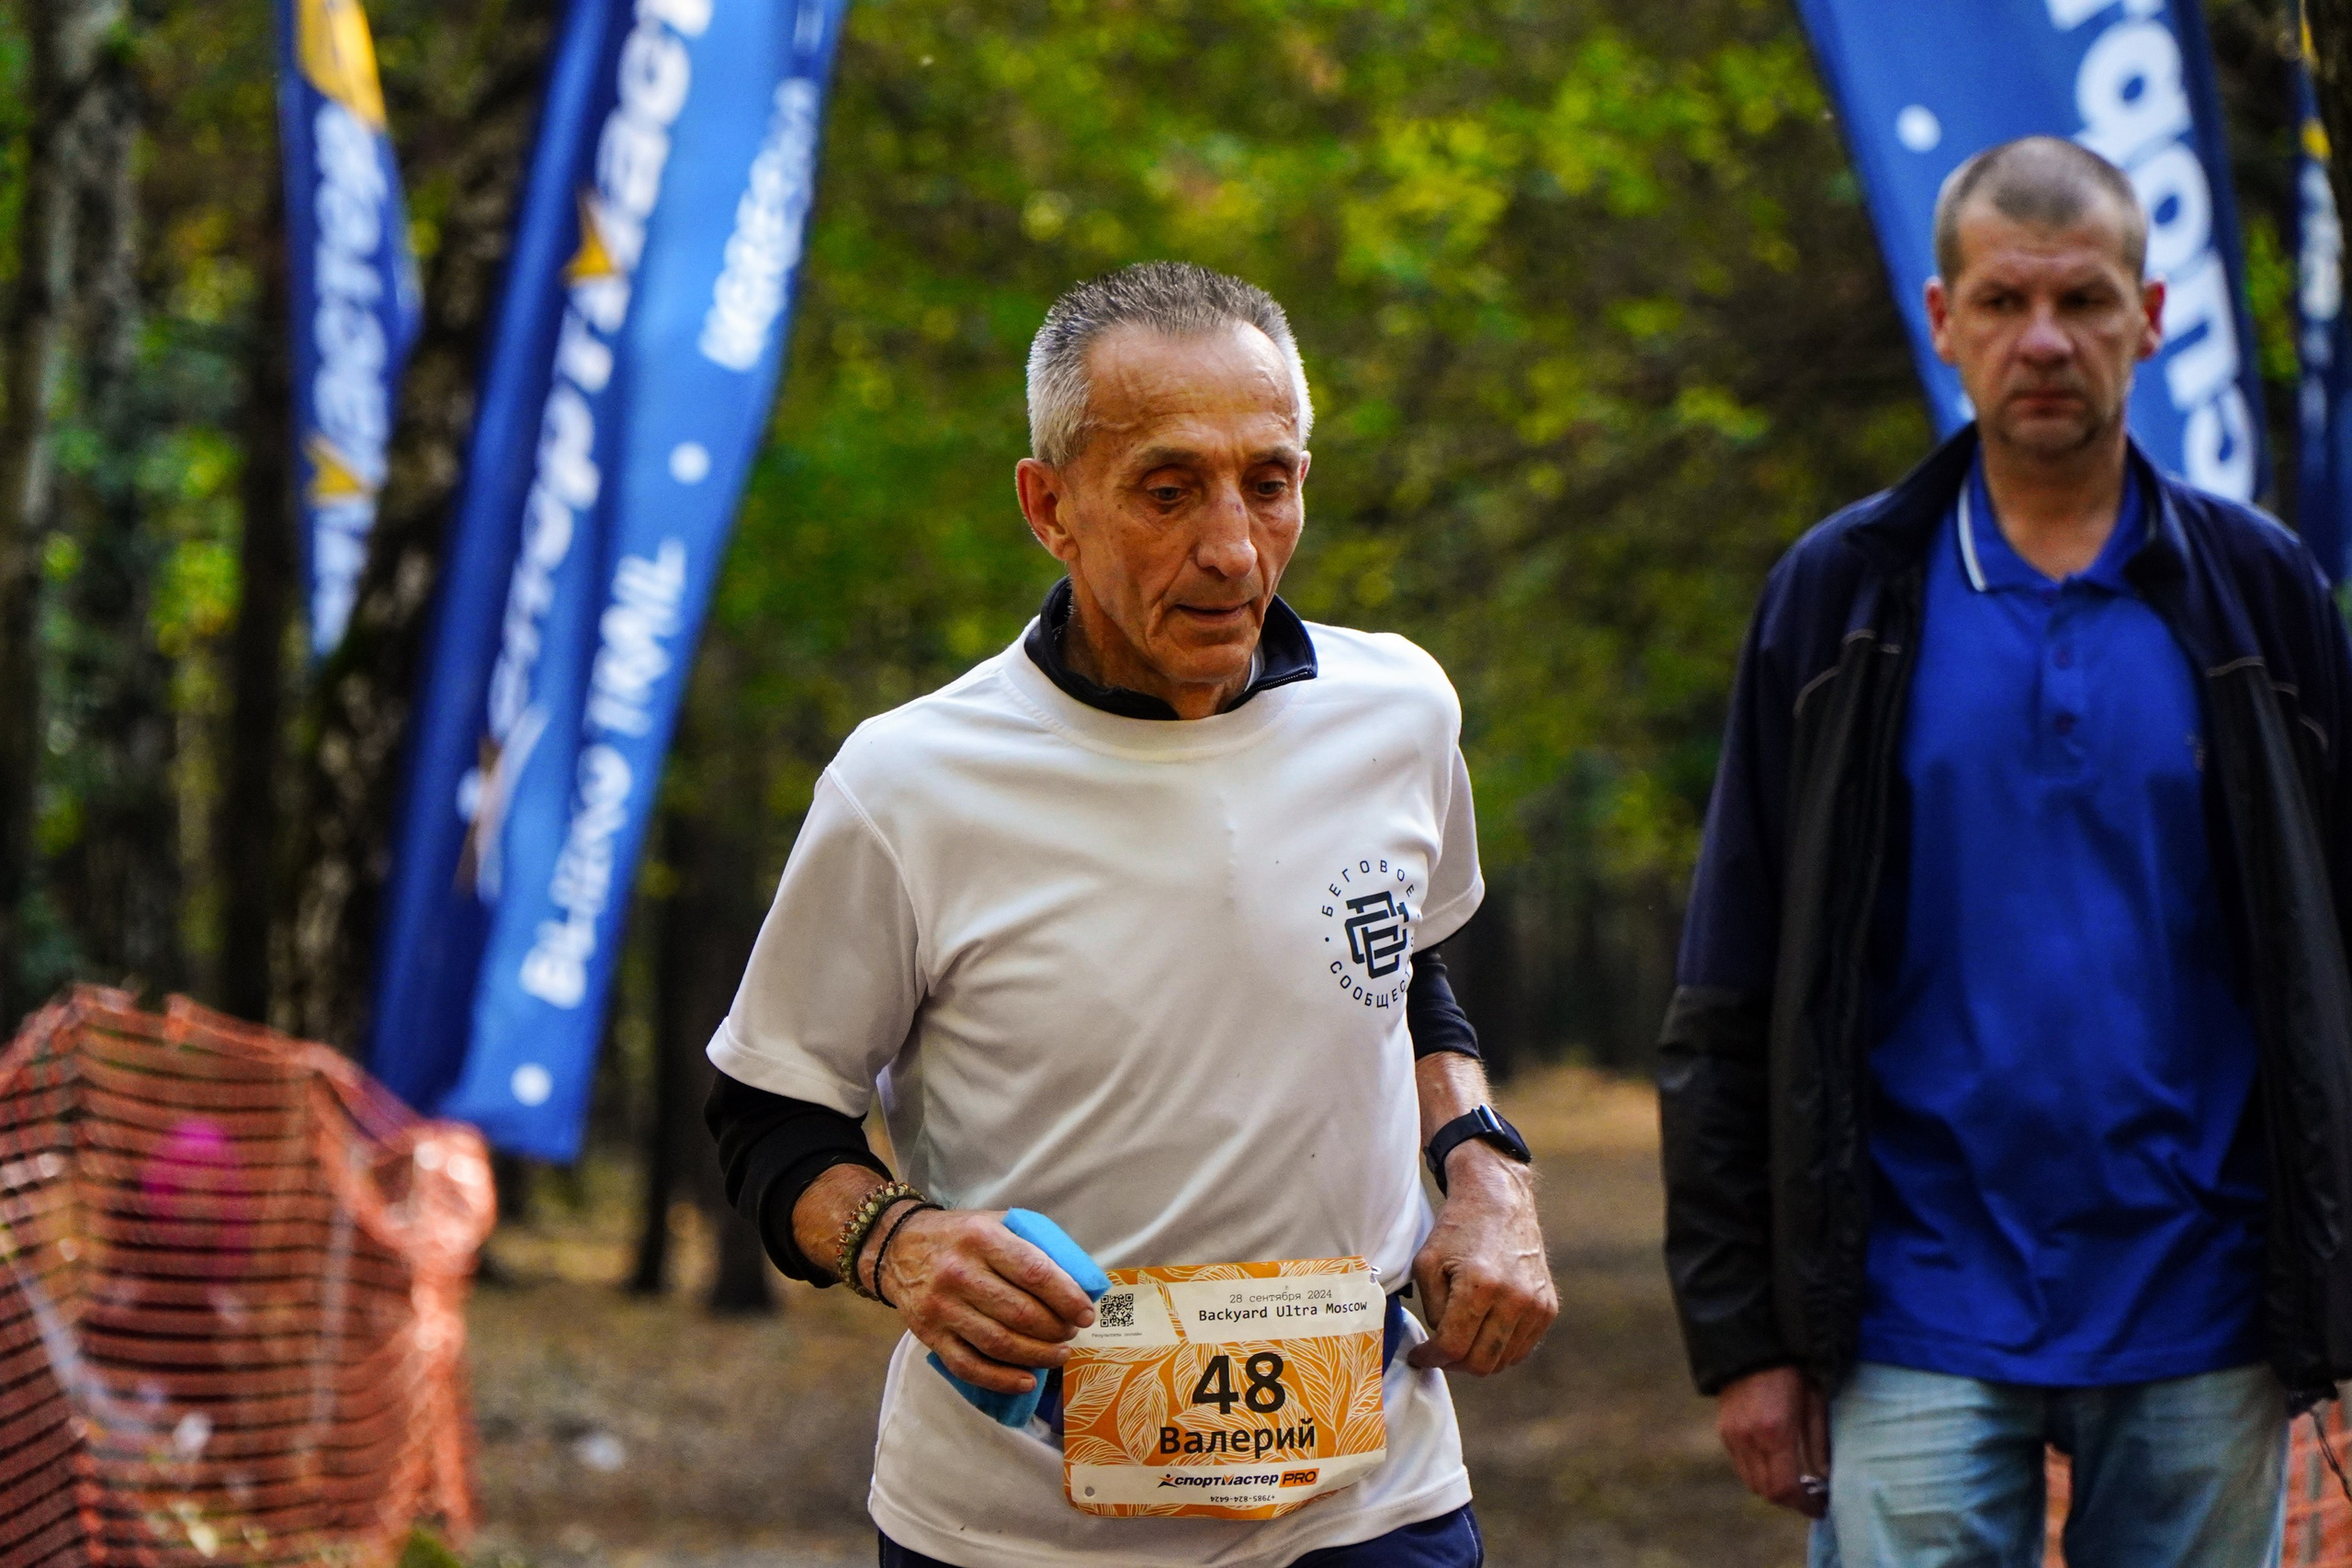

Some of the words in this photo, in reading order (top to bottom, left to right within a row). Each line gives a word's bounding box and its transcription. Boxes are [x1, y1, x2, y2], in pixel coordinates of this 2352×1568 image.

[1322, 860, 1415, 918] БЕГОВОЕ
[1198, 1306, 1268, 1323] Backyard
[1276, 1304, 1317, 1317] Ultra
[1326, 1301, 1368, 1314] Moscow
[1229, 1293, 1243, 1303] 28
[1249, 1292, 1302, 1303] сентября
[1307, 1289, 1332, 1300] 2024
[1193, 1351, 1286, 1416] 48
[1159, 1417, 1316, 1459] Валерий
[1282, 1471, 1317, 1485] PRO
